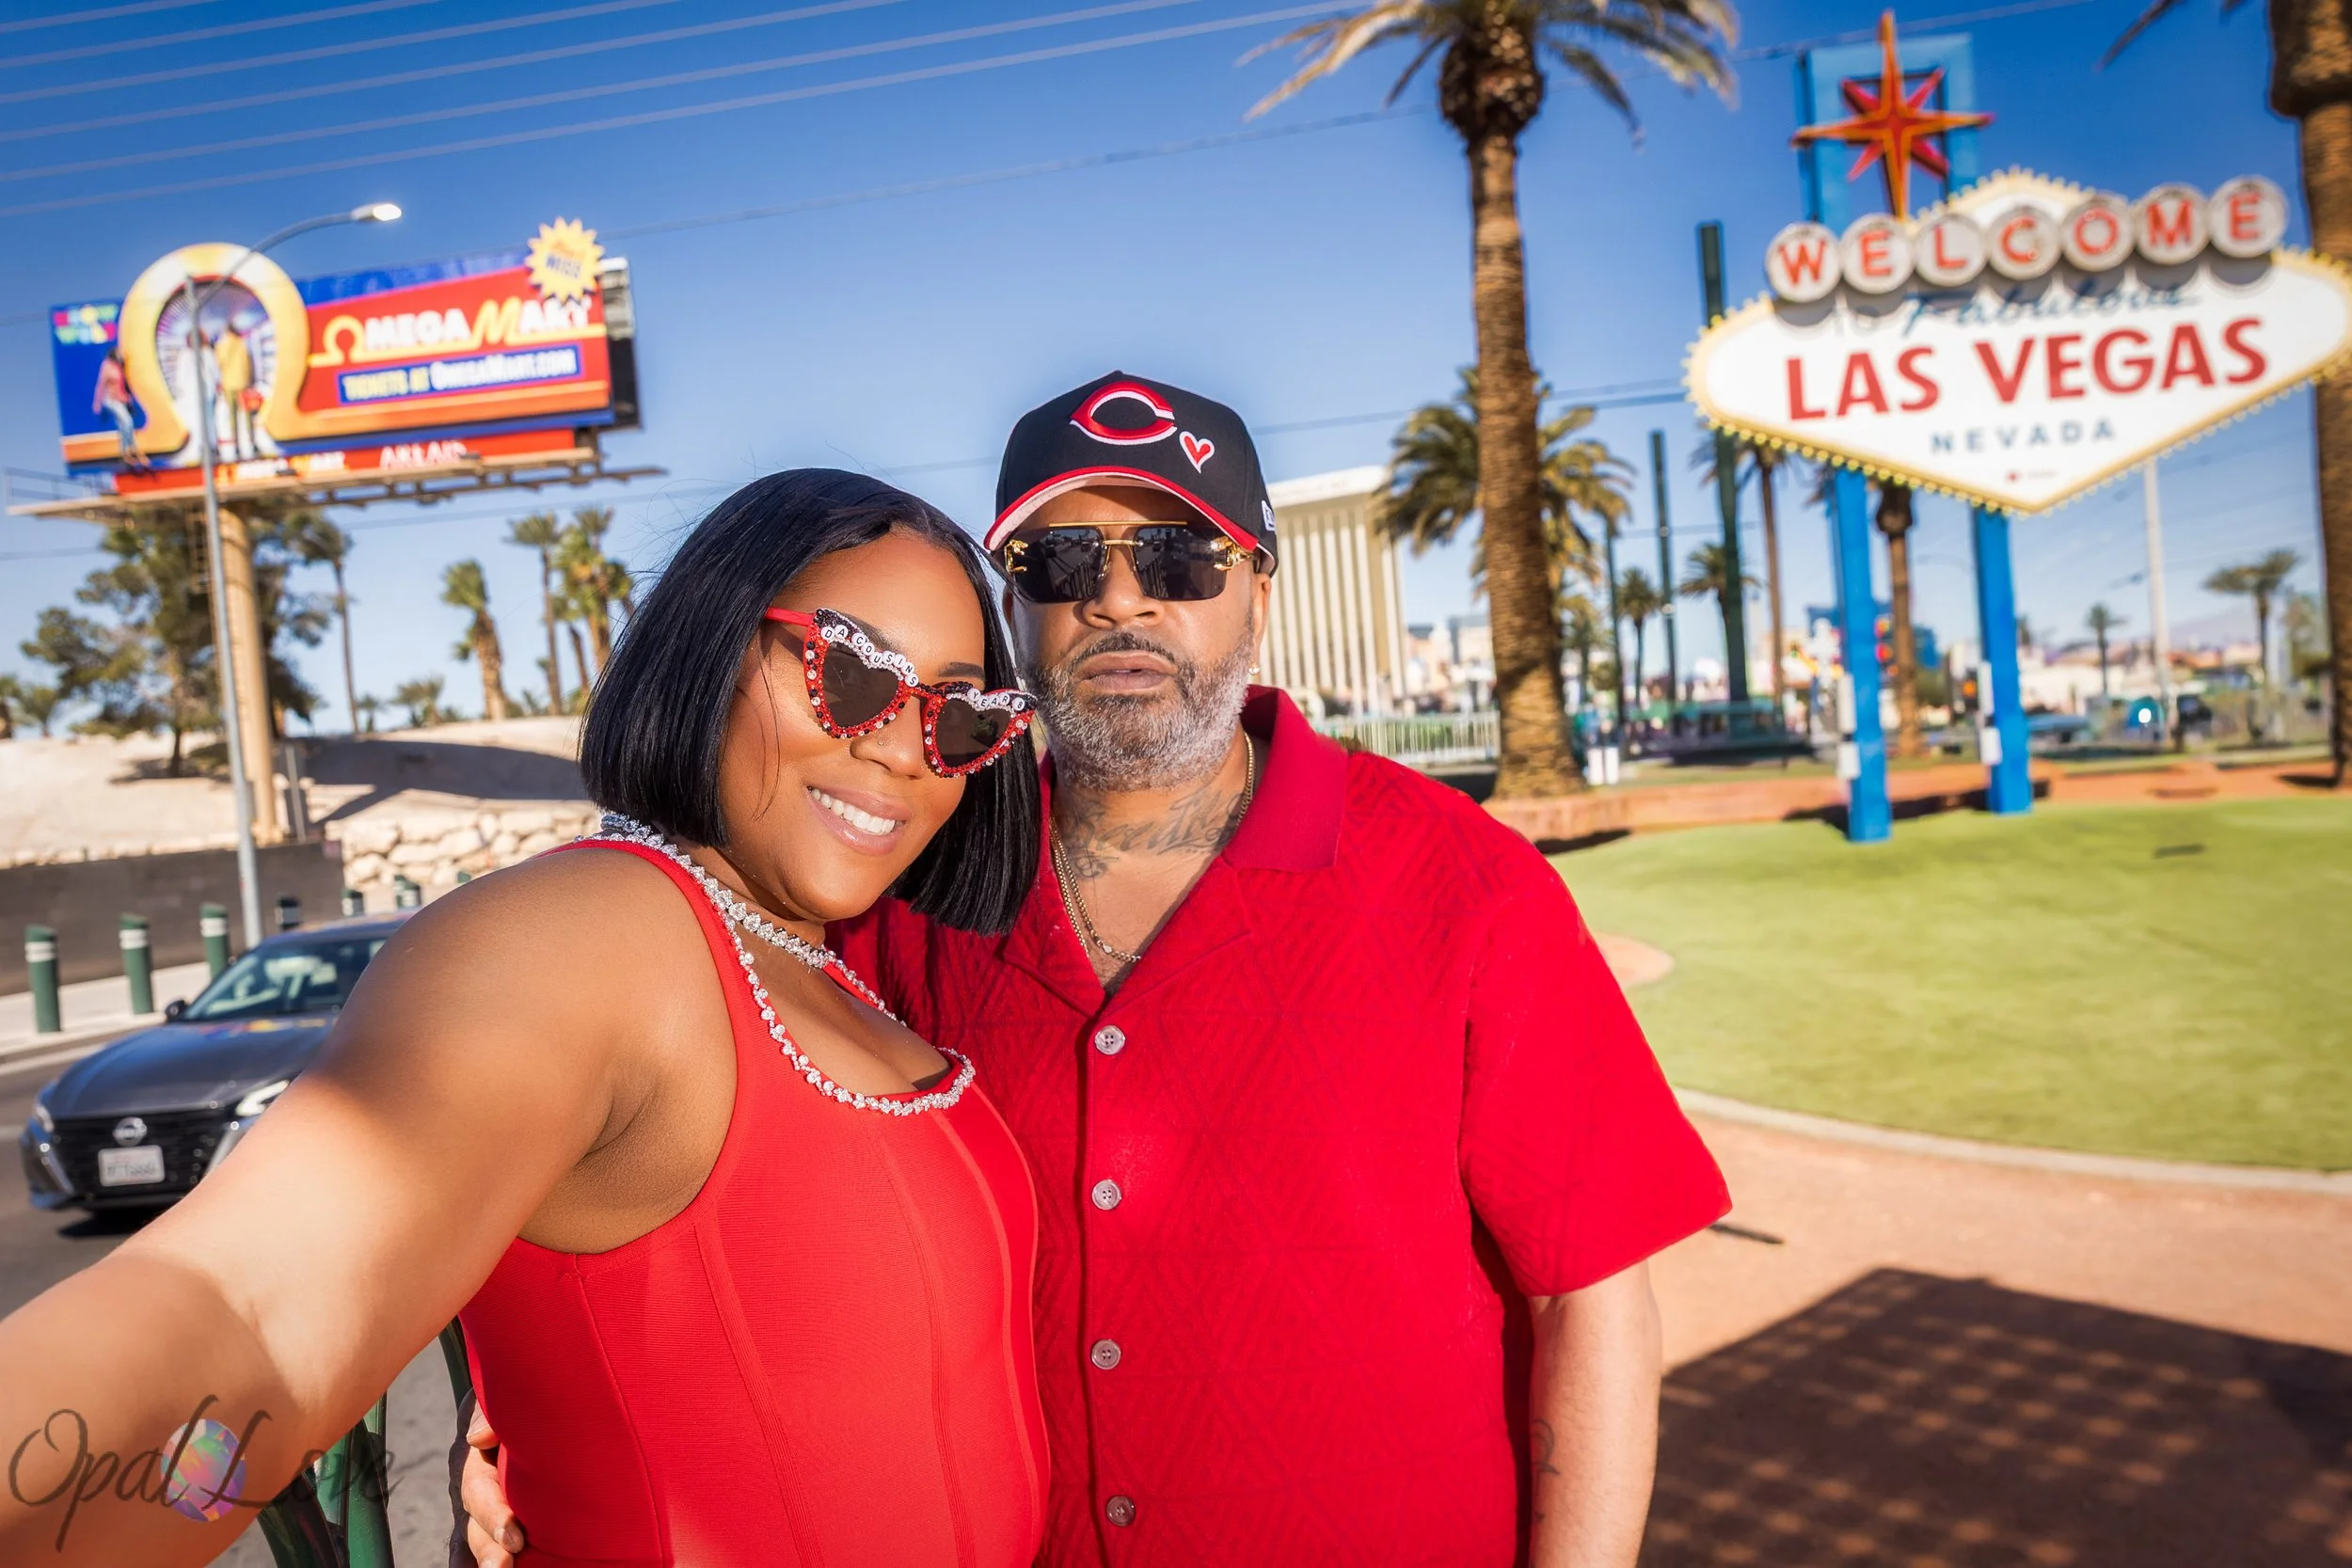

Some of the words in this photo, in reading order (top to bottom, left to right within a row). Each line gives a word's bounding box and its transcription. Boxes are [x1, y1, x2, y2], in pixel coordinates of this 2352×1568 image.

[1777, 192, 2267, 286] WELCOME
[1787, 345, 1943, 421] LAS
[1974, 317, 2268, 404] VEGAS
[1070, 380, 1177, 446] C
[1930, 419, 2118, 454] NEVADA
[821, 626, 848, 641] DA
[854, 635, 918, 686] COUSINS
[971, 691, 1010, 707] YEAR
